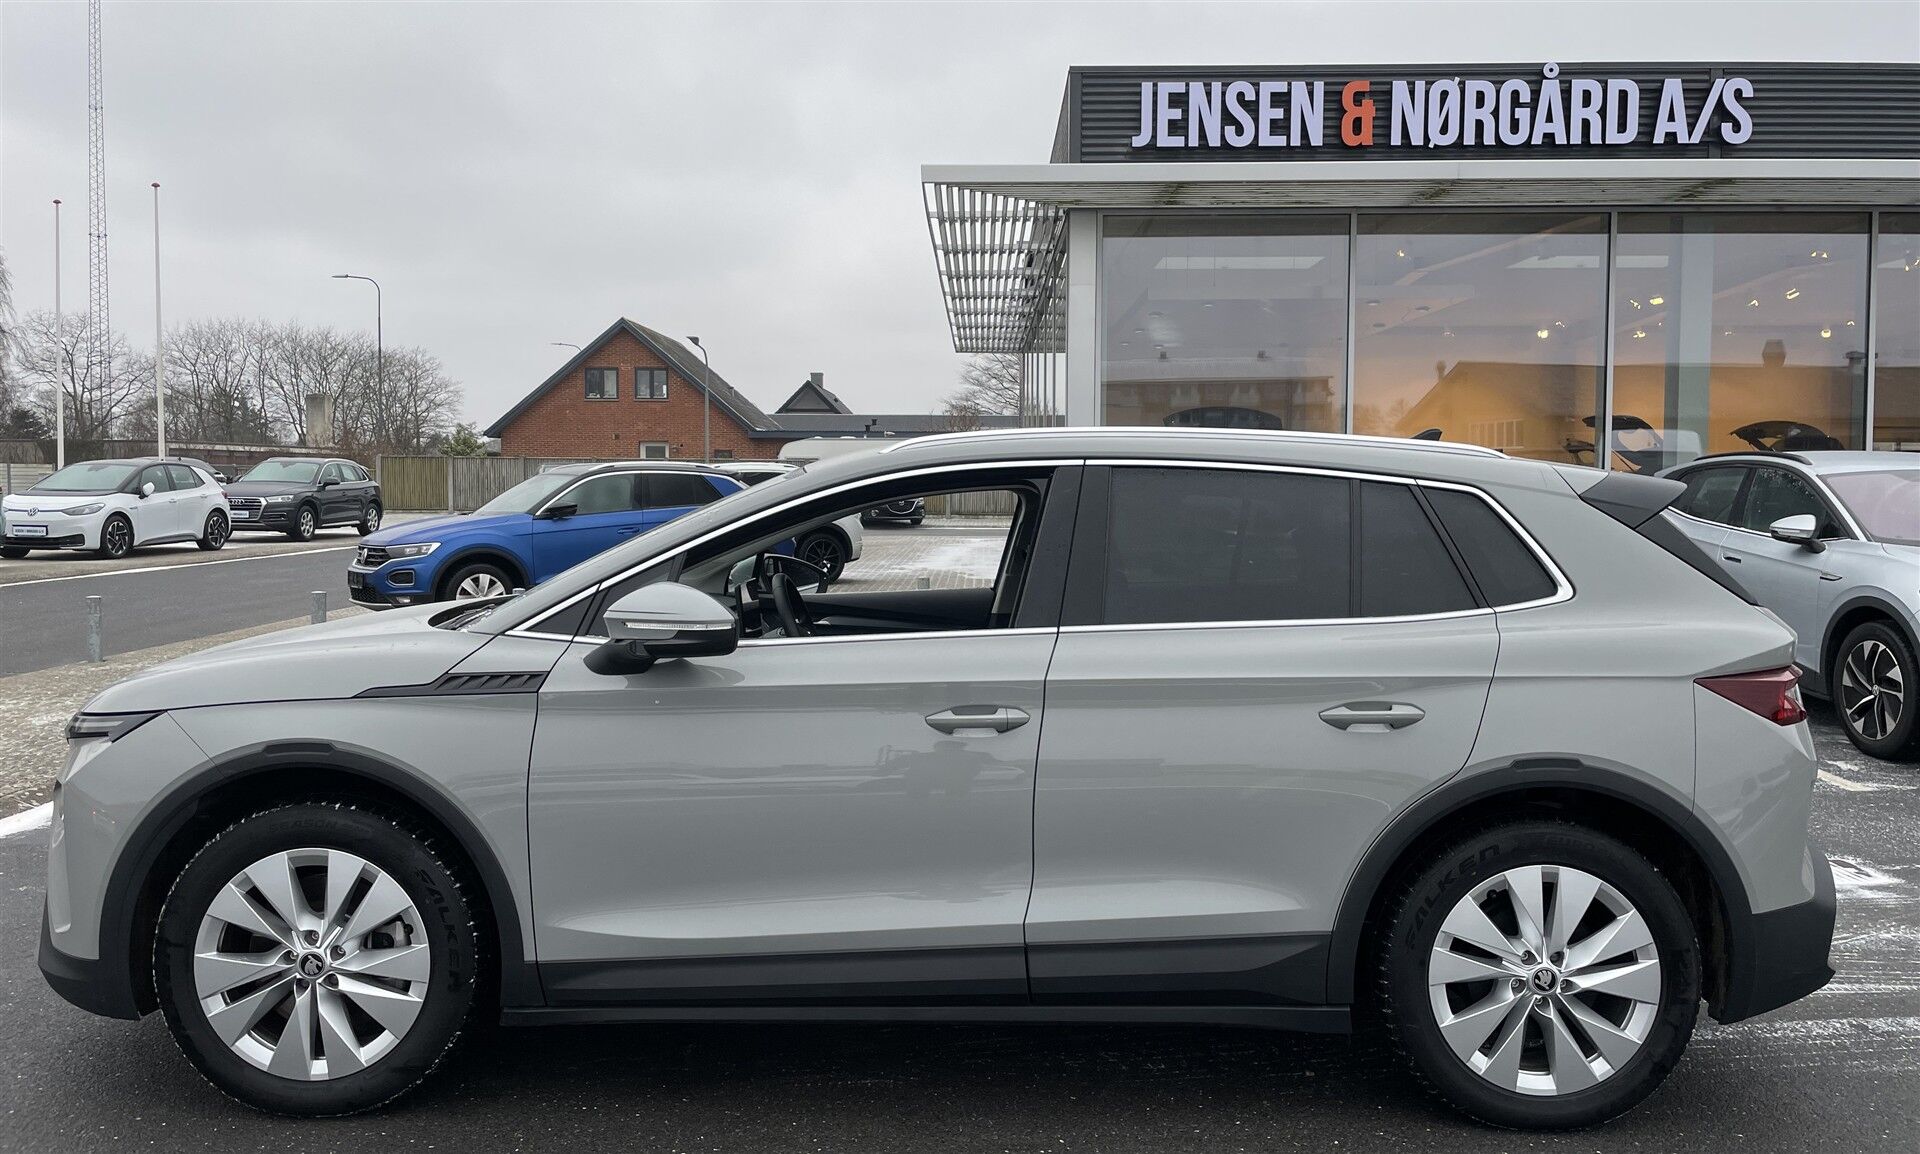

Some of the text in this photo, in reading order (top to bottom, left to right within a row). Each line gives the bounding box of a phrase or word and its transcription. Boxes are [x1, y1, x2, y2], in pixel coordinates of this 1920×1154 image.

[1131, 62, 1754, 148] JENSEN & NØRGÅRD A/S
[414, 866, 462, 993] FALKEN
[1405, 844, 1501, 951] FALKEN
